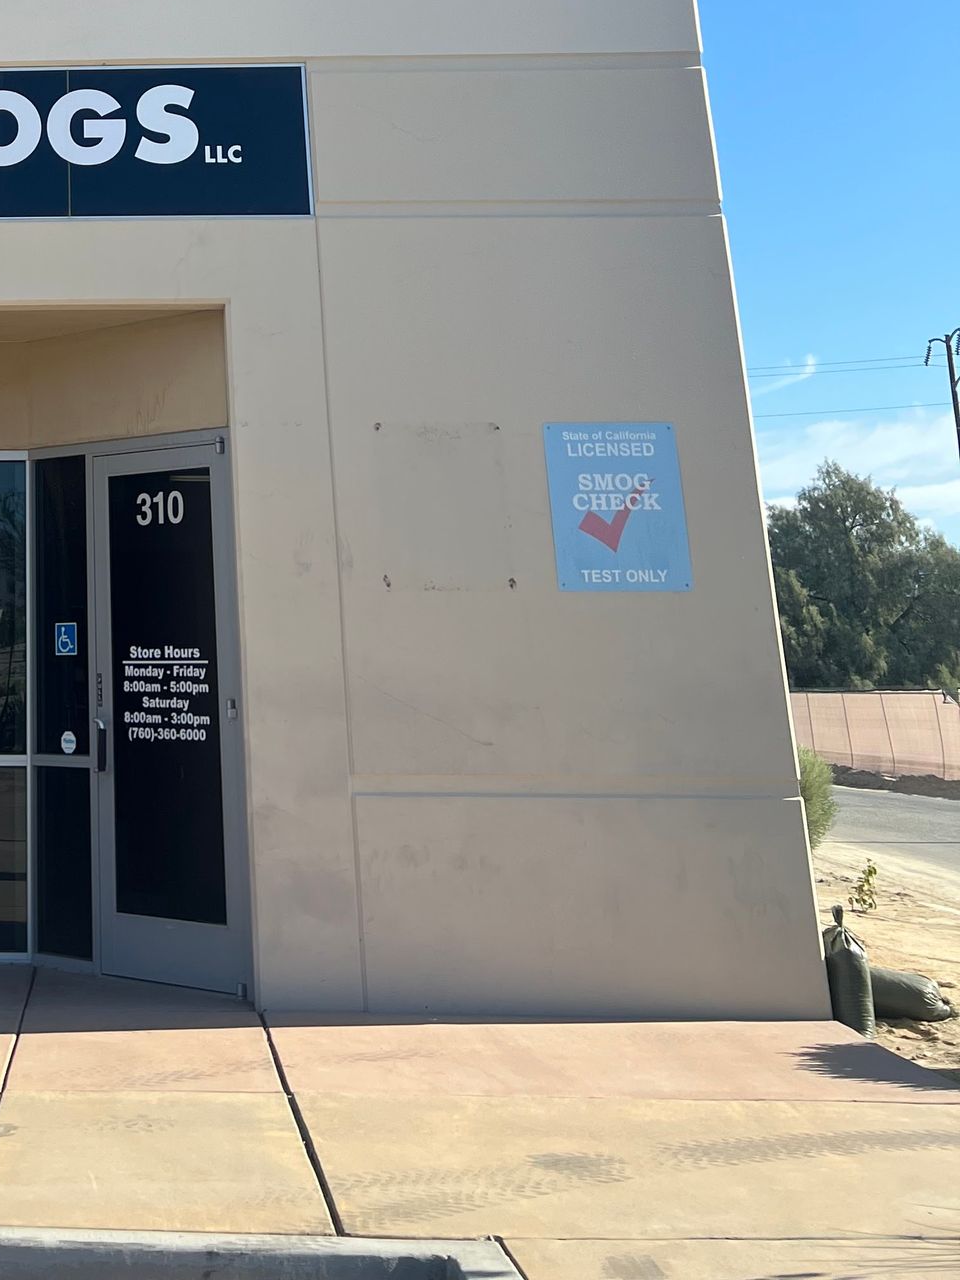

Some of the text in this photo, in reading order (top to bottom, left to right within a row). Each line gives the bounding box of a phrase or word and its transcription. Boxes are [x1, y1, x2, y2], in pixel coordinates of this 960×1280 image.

[204, 145, 243, 164] LLC
[562, 430, 656, 441] State of California
[567, 442, 654, 457] LICENSED
[578, 473, 651, 491] SMOG
[136, 490, 184, 526] 310
[572, 493, 662, 511] CHECK
[581, 570, 668, 583] TEST ONLY
[129, 645, 200, 658] Store Hours
[124, 665, 164, 679] Monday
[173, 665, 206, 680] Friday
[123, 680, 161, 692] 8:00am
[169, 681, 209, 695] 5:00pm
[142, 696, 189, 711] Saturday
[124, 711, 162, 723] 8:00am
[170, 712, 210, 727] 3:00pm
[128, 727, 207, 742] (760)-360-6000
